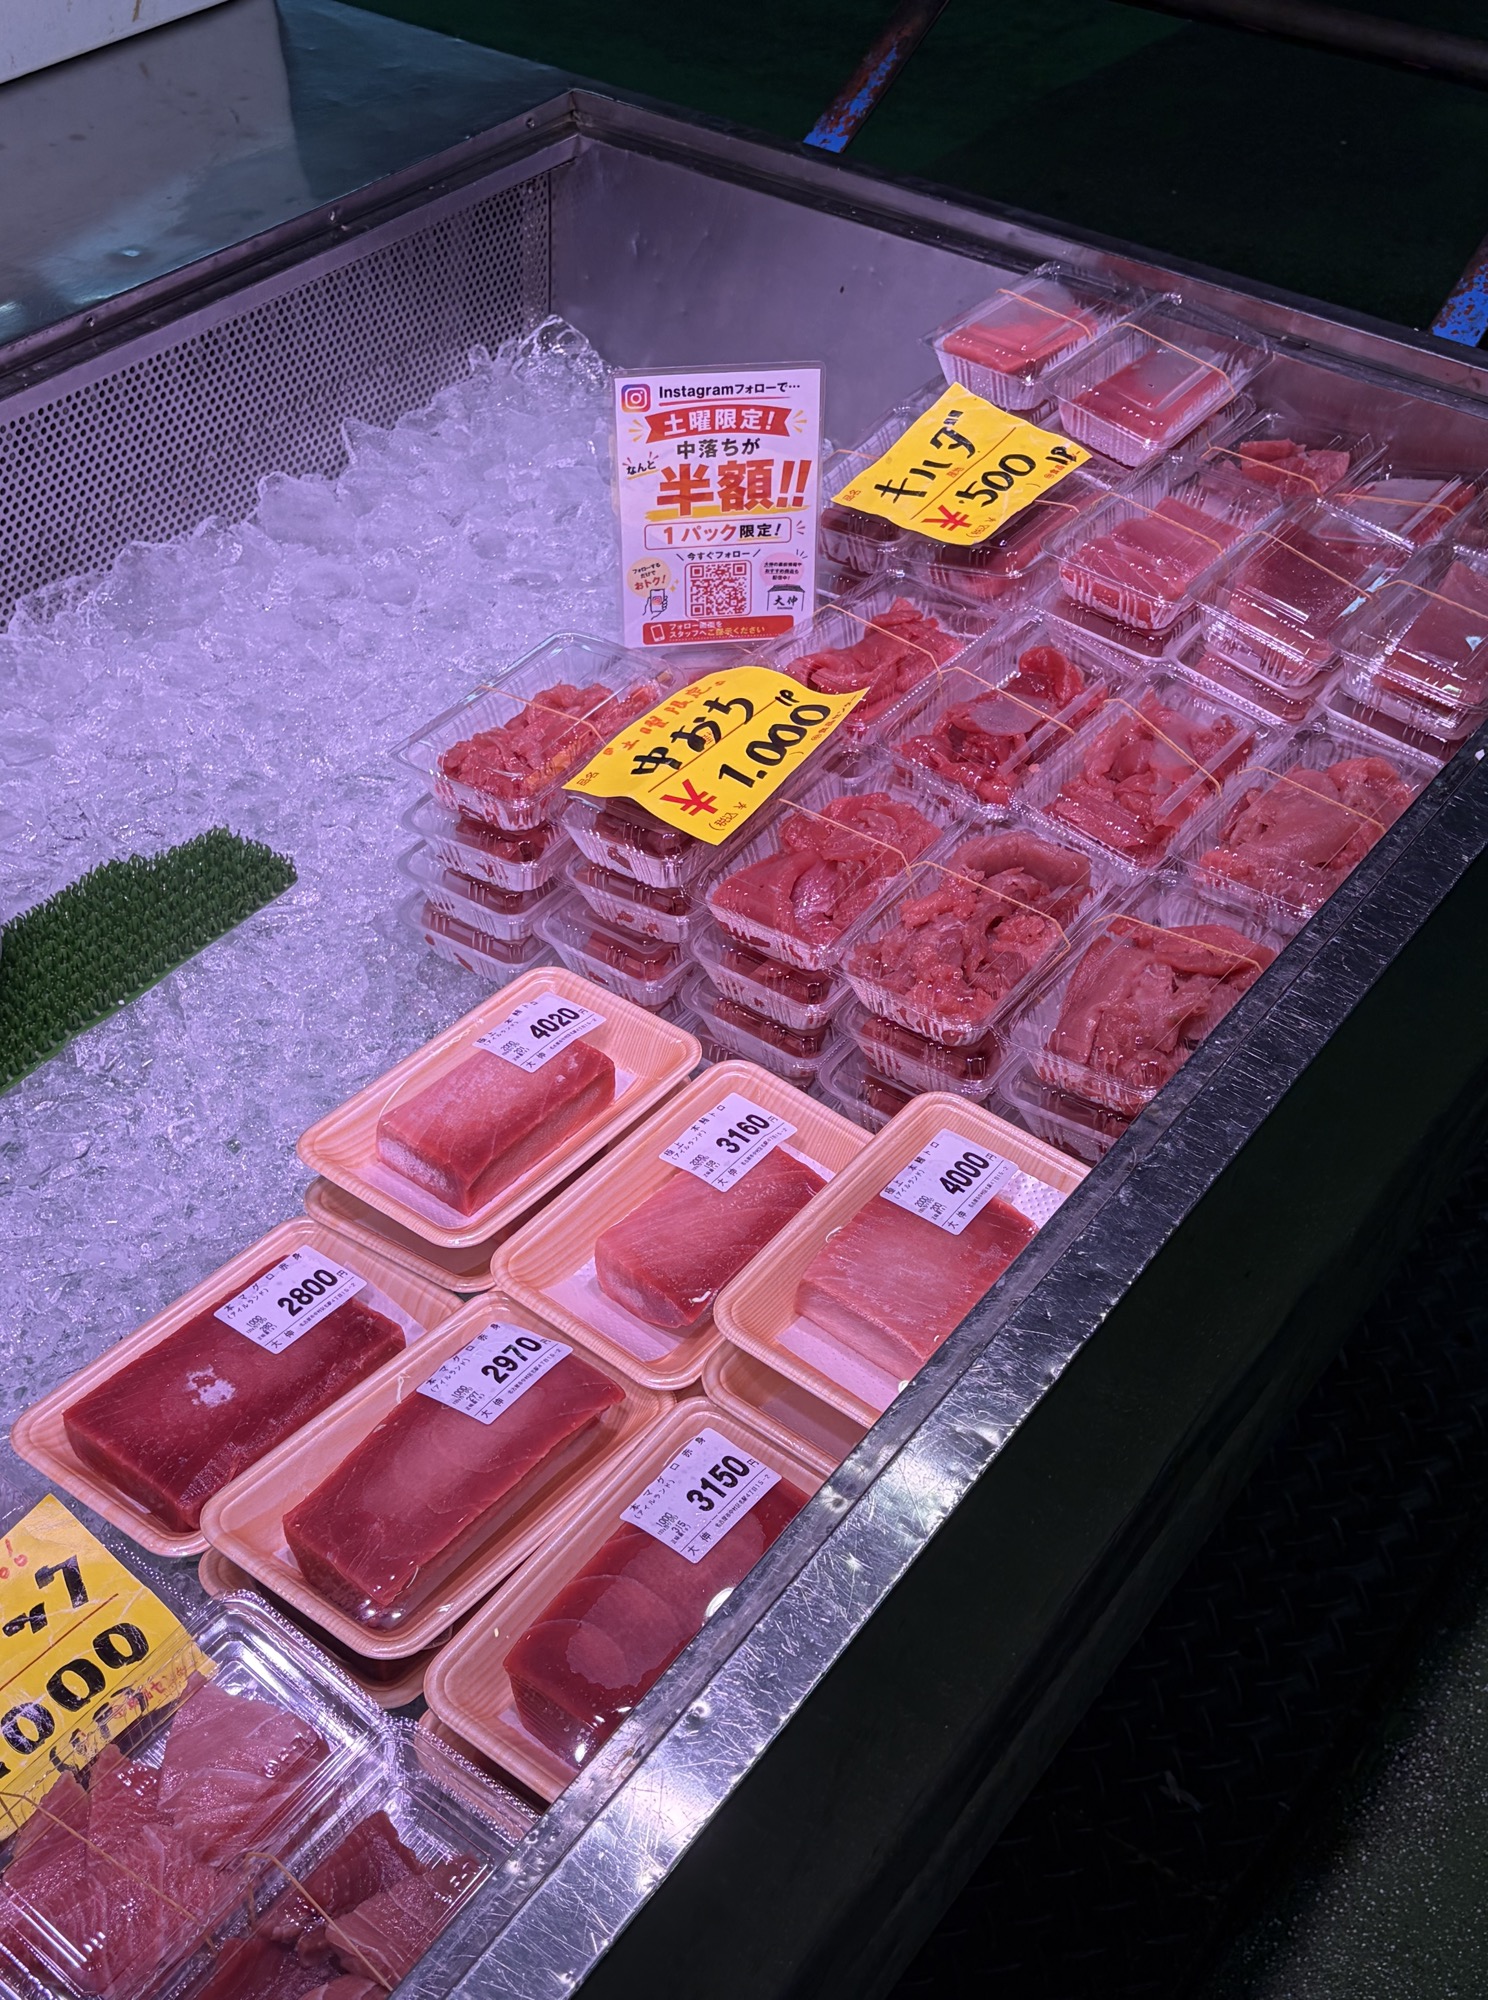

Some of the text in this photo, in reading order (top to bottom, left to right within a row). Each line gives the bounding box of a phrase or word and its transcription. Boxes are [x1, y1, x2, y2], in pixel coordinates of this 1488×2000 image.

[676, 437, 760, 460] 中落ちが
[873, 410, 976, 503] キハダ
[625, 459, 657, 476] なんと
[687, 550, 751, 562] 今すぐフォロー
[630, 696, 755, 776] 中おち
[633, 1479, 676, 1519] (アイルランド)
